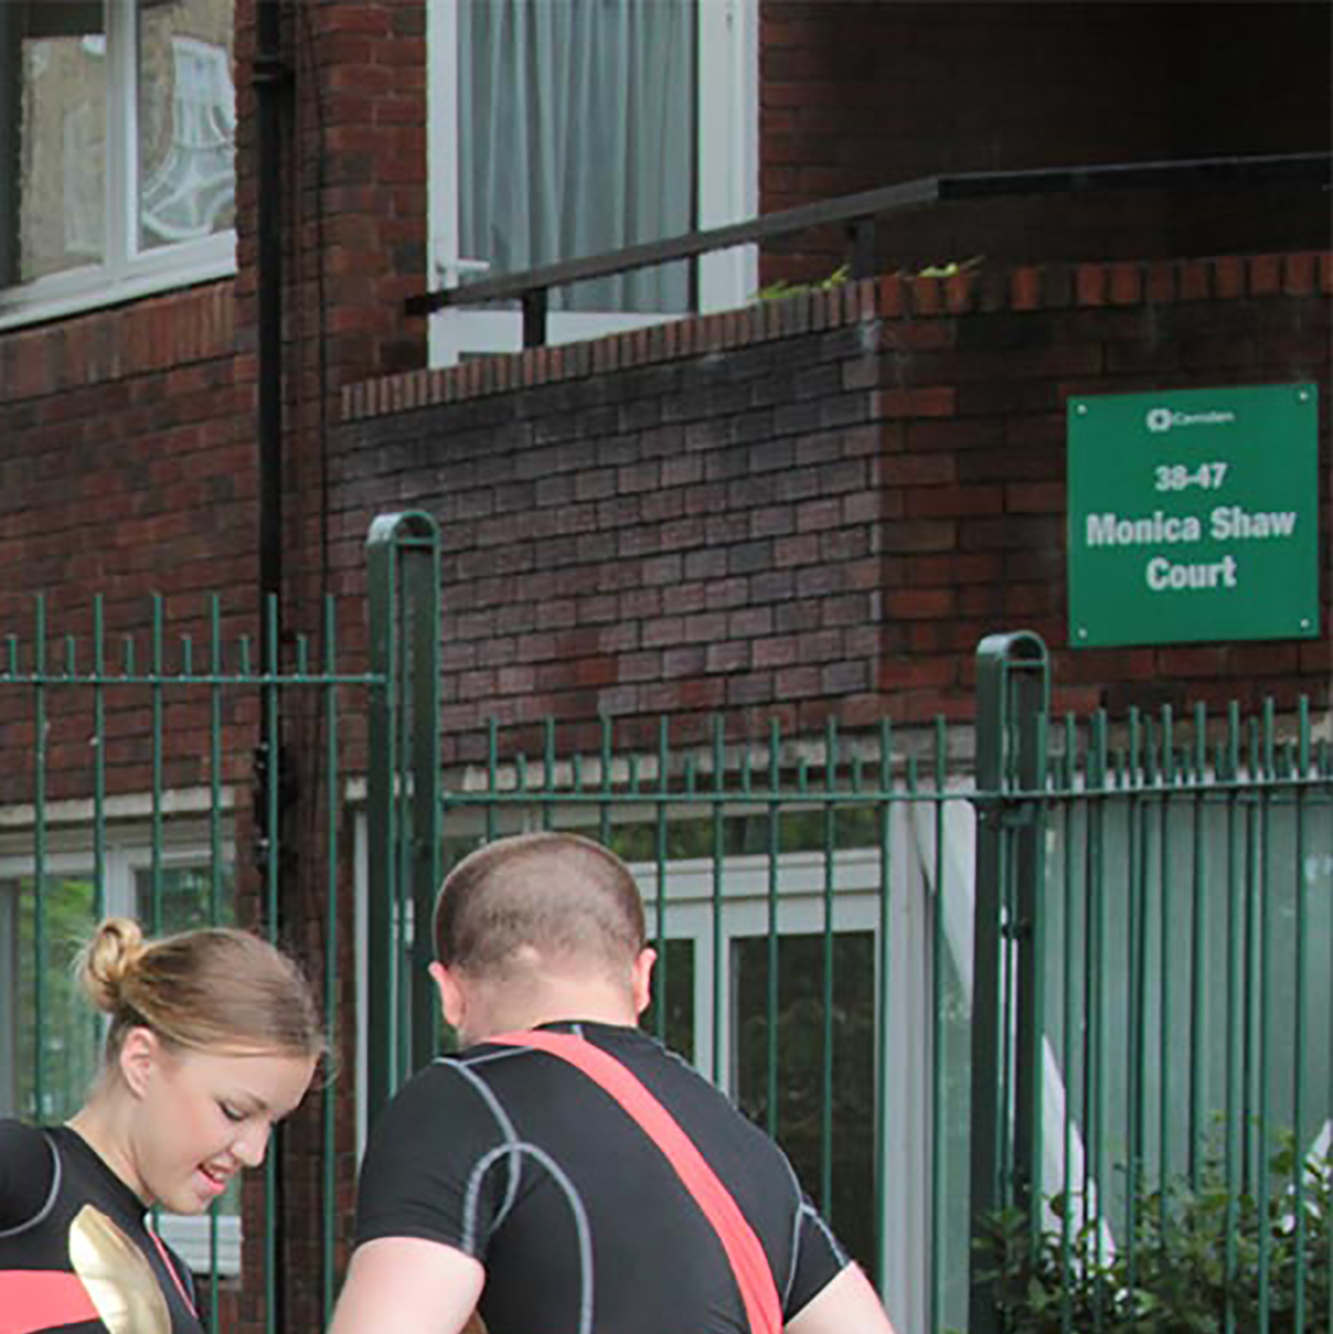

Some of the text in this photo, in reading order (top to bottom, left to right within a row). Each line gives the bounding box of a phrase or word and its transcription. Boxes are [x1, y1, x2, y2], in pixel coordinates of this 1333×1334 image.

[1154, 462, 1229, 491] 38-47
[1086, 506, 1297, 546] Monica Shaw
[1146, 554, 1237, 590] Court
